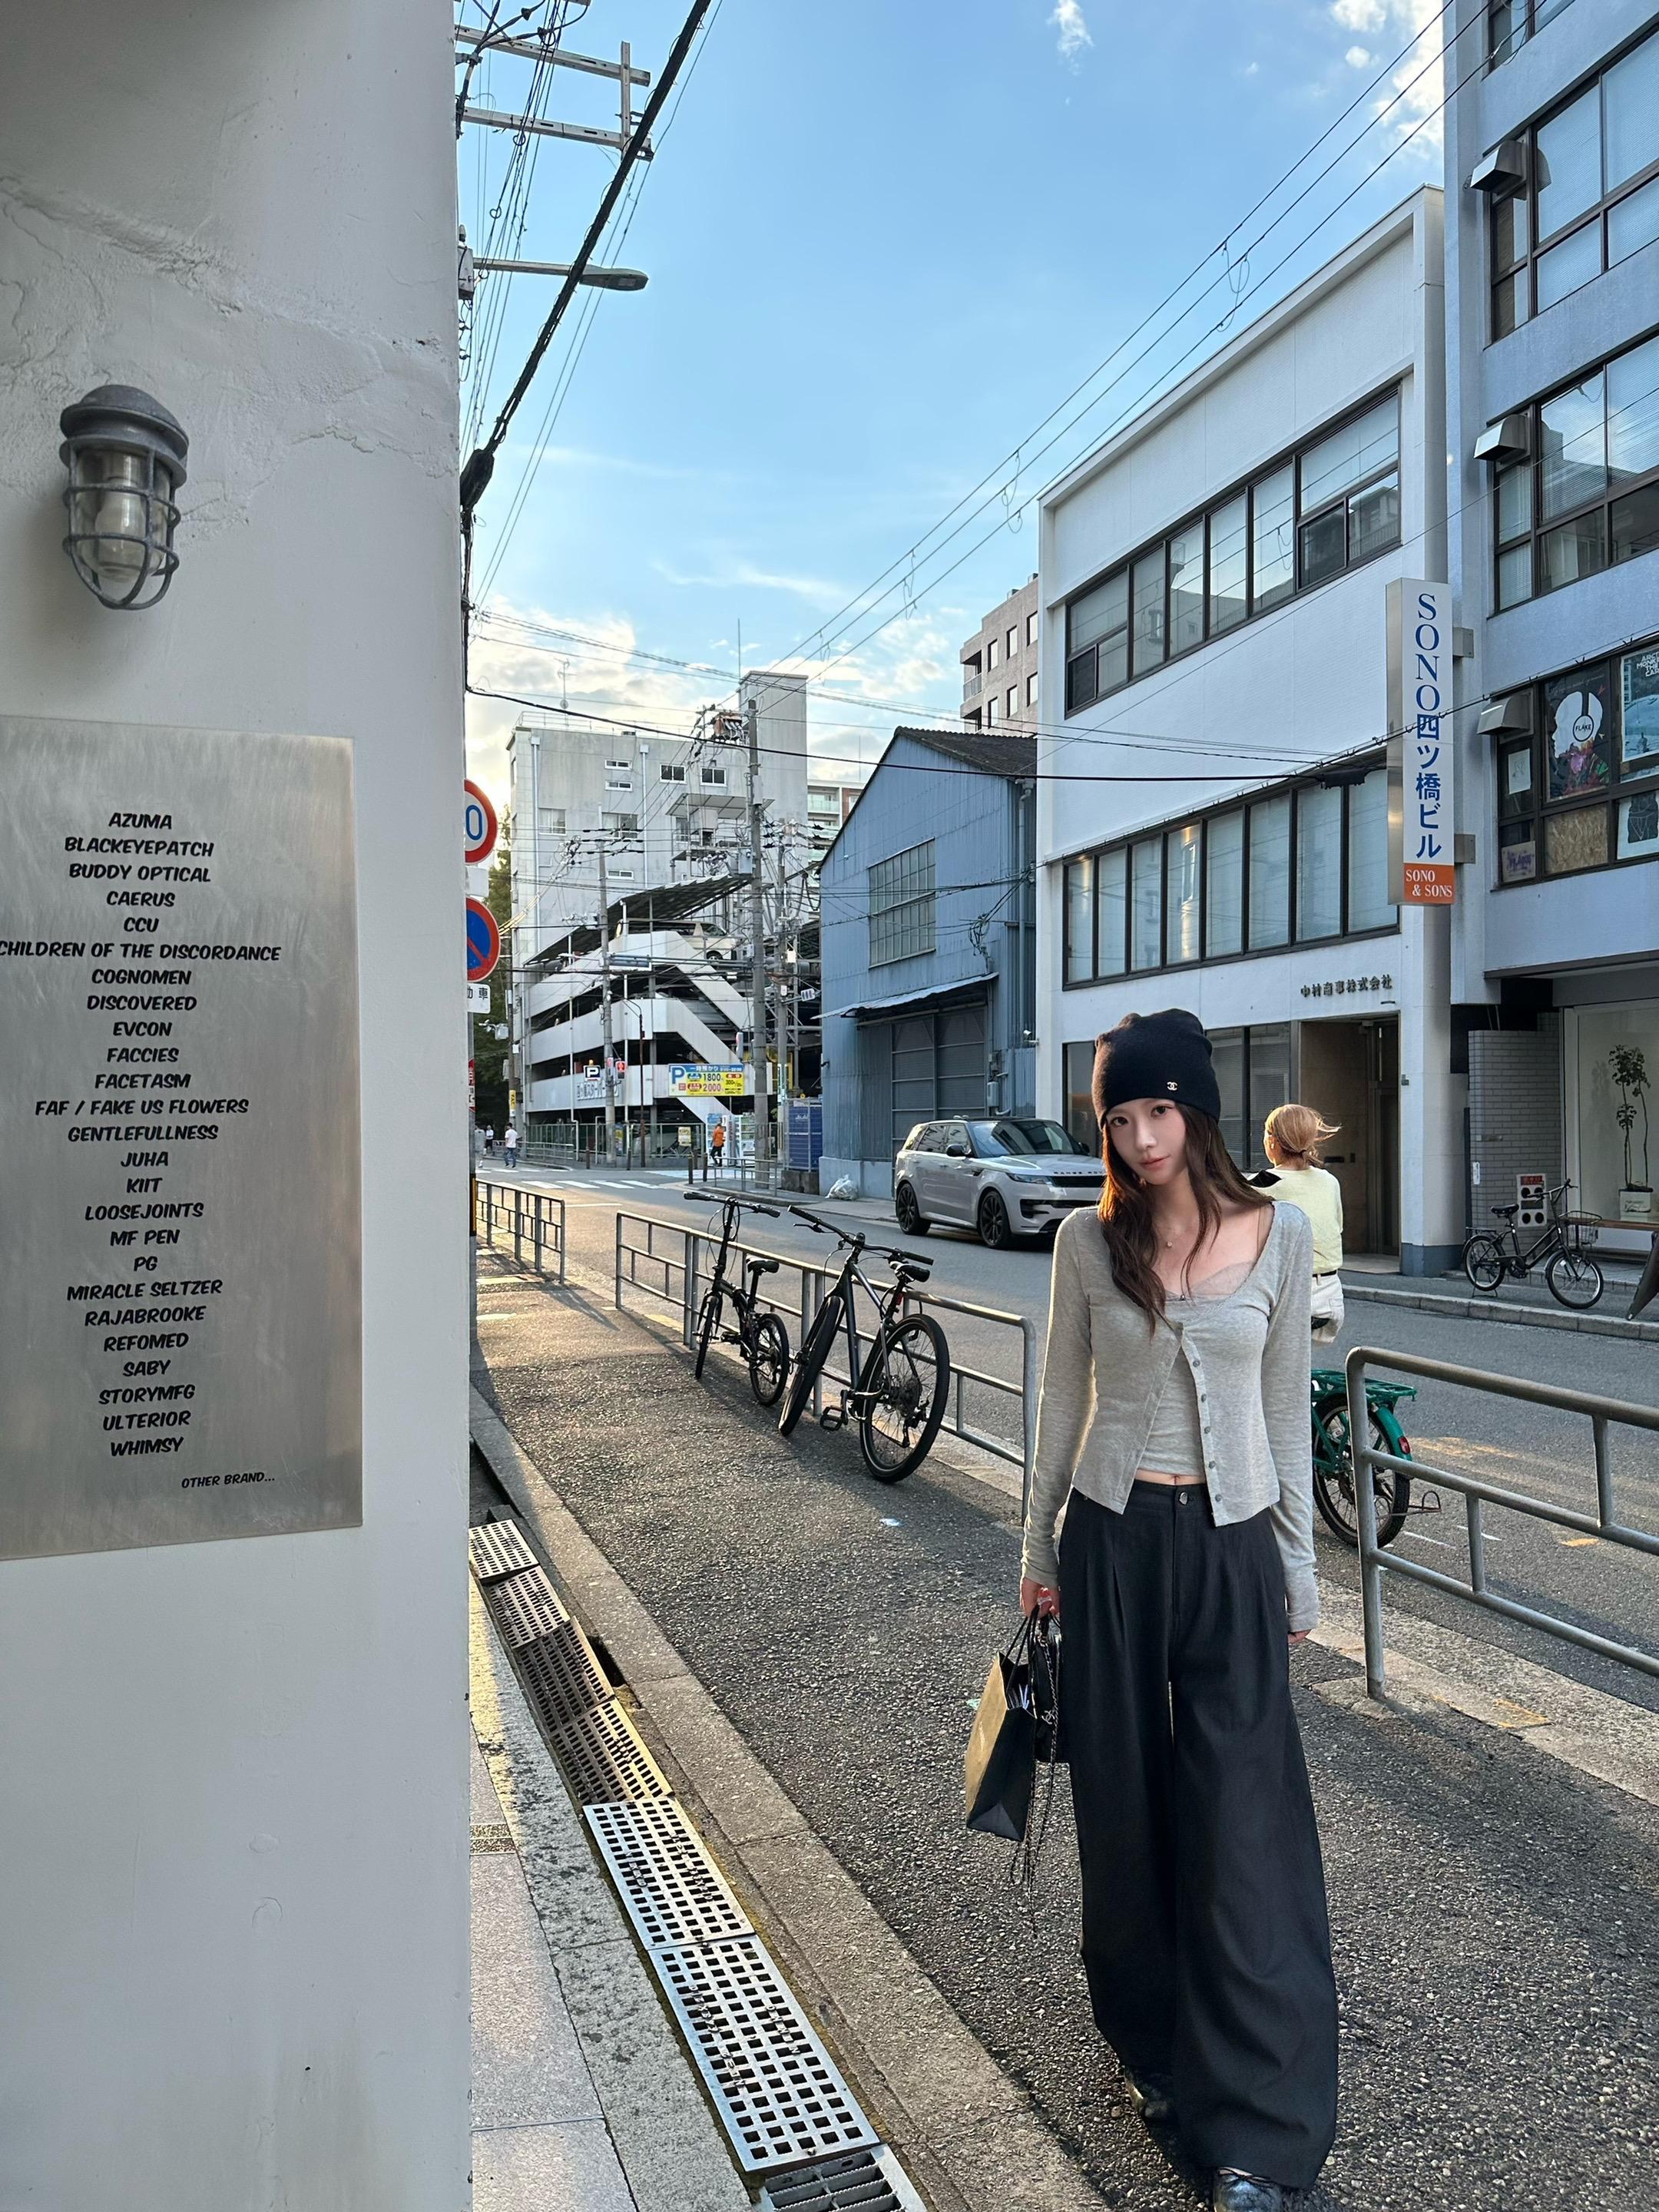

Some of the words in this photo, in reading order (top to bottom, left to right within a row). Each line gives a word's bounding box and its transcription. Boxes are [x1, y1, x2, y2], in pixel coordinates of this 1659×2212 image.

[108, 812, 172, 830] AZUMA
[465, 804, 483, 841] 0
[65, 836, 214, 857] BLACKEYEPATCH
[69, 863, 132, 880] BUDDY
[137, 866, 211, 882] OPTICAL
[1406, 869, 1435, 882] SONO
[106, 890, 176, 908] CAERUS
[1412, 883, 1422, 897] &
[1424, 884, 1452, 898] SONS
[123, 916, 160, 933] CCU
[0, 940, 86, 957] CHILDREN
[91, 942, 115, 958] OF
[119, 942, 155, 959] THE
[159, 944, 282, 962] DISCORDANCE
[91, 969, 192, 985] COGNOMEN
[1300, 973, 1392, 998] 中村商事株式会社
[87, 995, 197, 1012] DISCOVERED
[112, 1021, 173, 1037] EVCON
[106, 1047, 180, 1063] FACCIES
[94, 1073, 192, 1089] FACETASM
[671, 1066, 685, 1084] P
[35, 1100, 70, 1116] FAF
[90, 1099, 136, 1115] FAKE
[141, 1099, 164, 1115] US
[168, 1098, 250, 1114] FLOWERS
[68, 1124, 219, 1143] GENTLEFULLNESS
[120, 1151, 169, 1167] JUHA
[126, 1177, 164, 1194] KIIT
[84, 1202, 204, 1221] LOOSEJOINTS
[110, 1230, 139, 1247] MF
[144, 1229, 180, 1246] PEN
[133, 1255, 158, 1272] PG
[66, 1282, 146, 1302] MIRACLE
[149, 1279, 224, 1297] SELTZER
[84, 1305, 207, 1327] RAJABROOKE
[103, 1332, 190, 1353] REFOMED
[122, 1359, 171, 1377] SABY
[98, 1383, 196, 1406] STORYMFG
[102, 1409, 192, 1432] ULTERIOR
[110, 1435, 184, 1457] WHIMSY
[180, 1475, 221, 1489] OTHER
